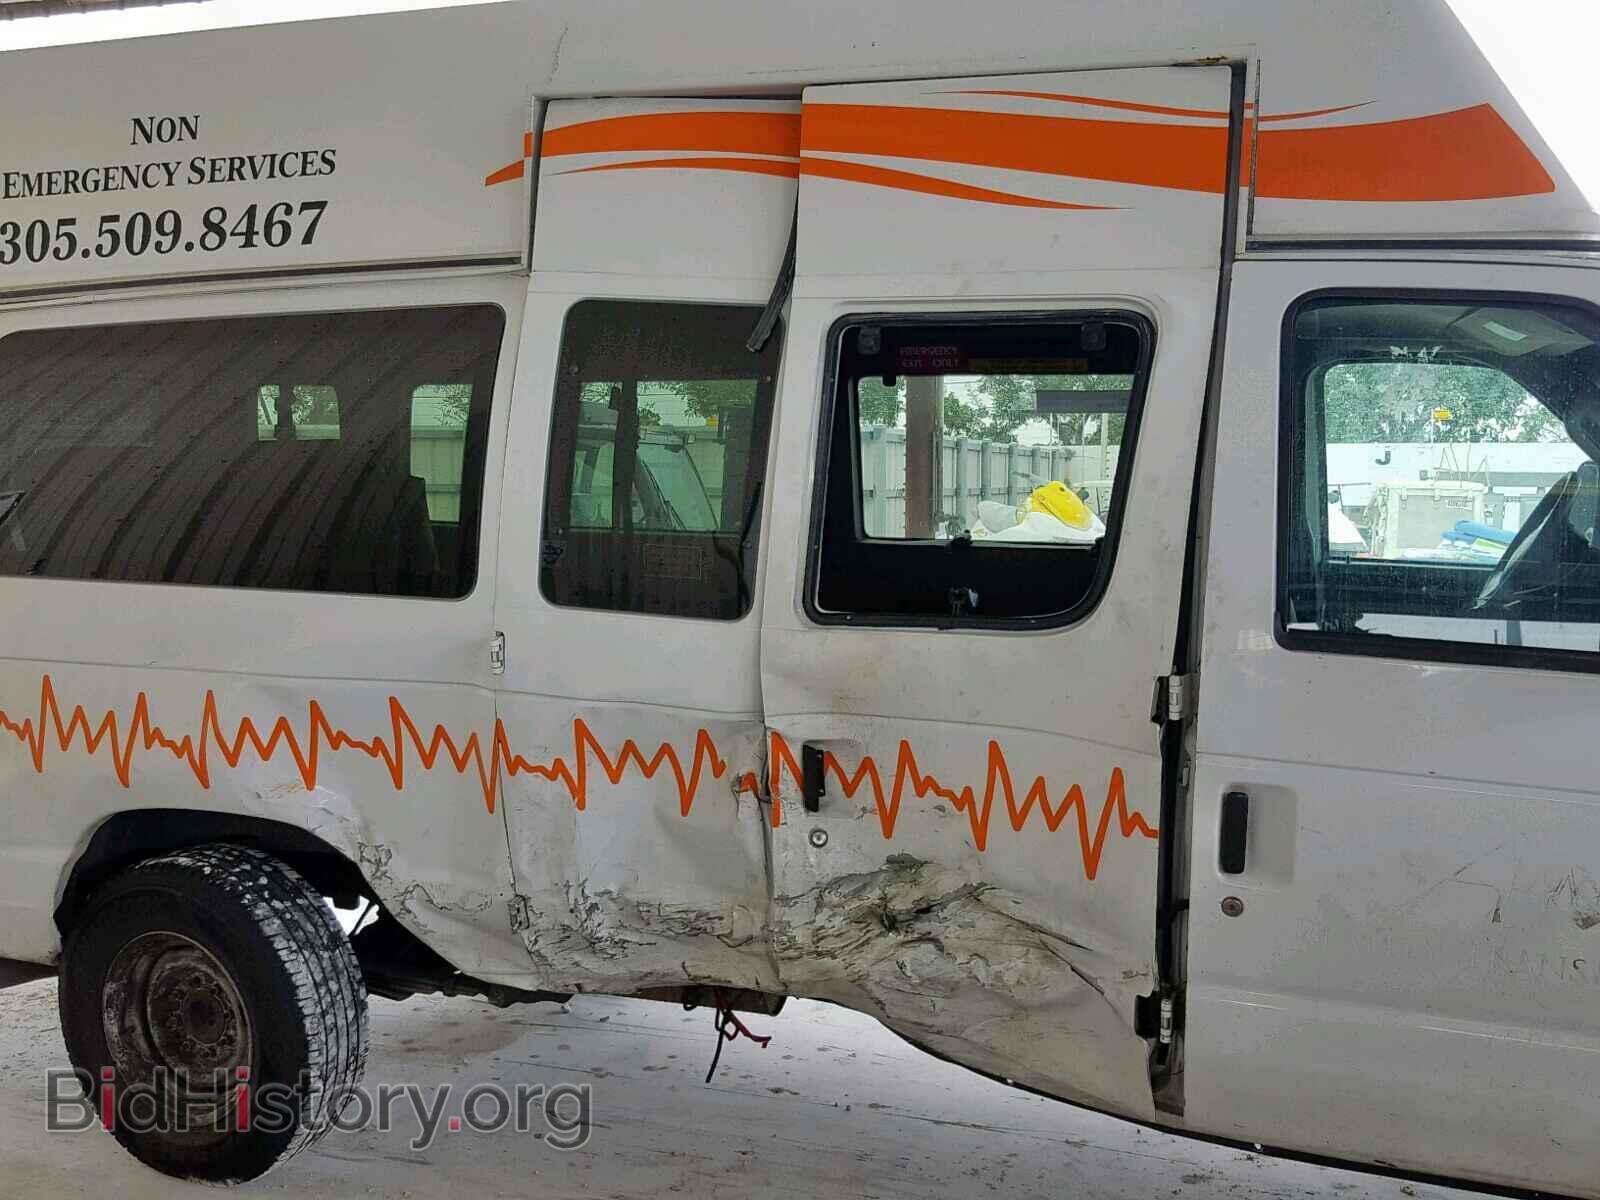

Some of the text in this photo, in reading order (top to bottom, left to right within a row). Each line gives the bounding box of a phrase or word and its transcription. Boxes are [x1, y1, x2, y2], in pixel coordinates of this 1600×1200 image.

[2, 149, 337, 199] EMERGENCY SERVICES
[0, 200, 328, 264] 305.509.8467
